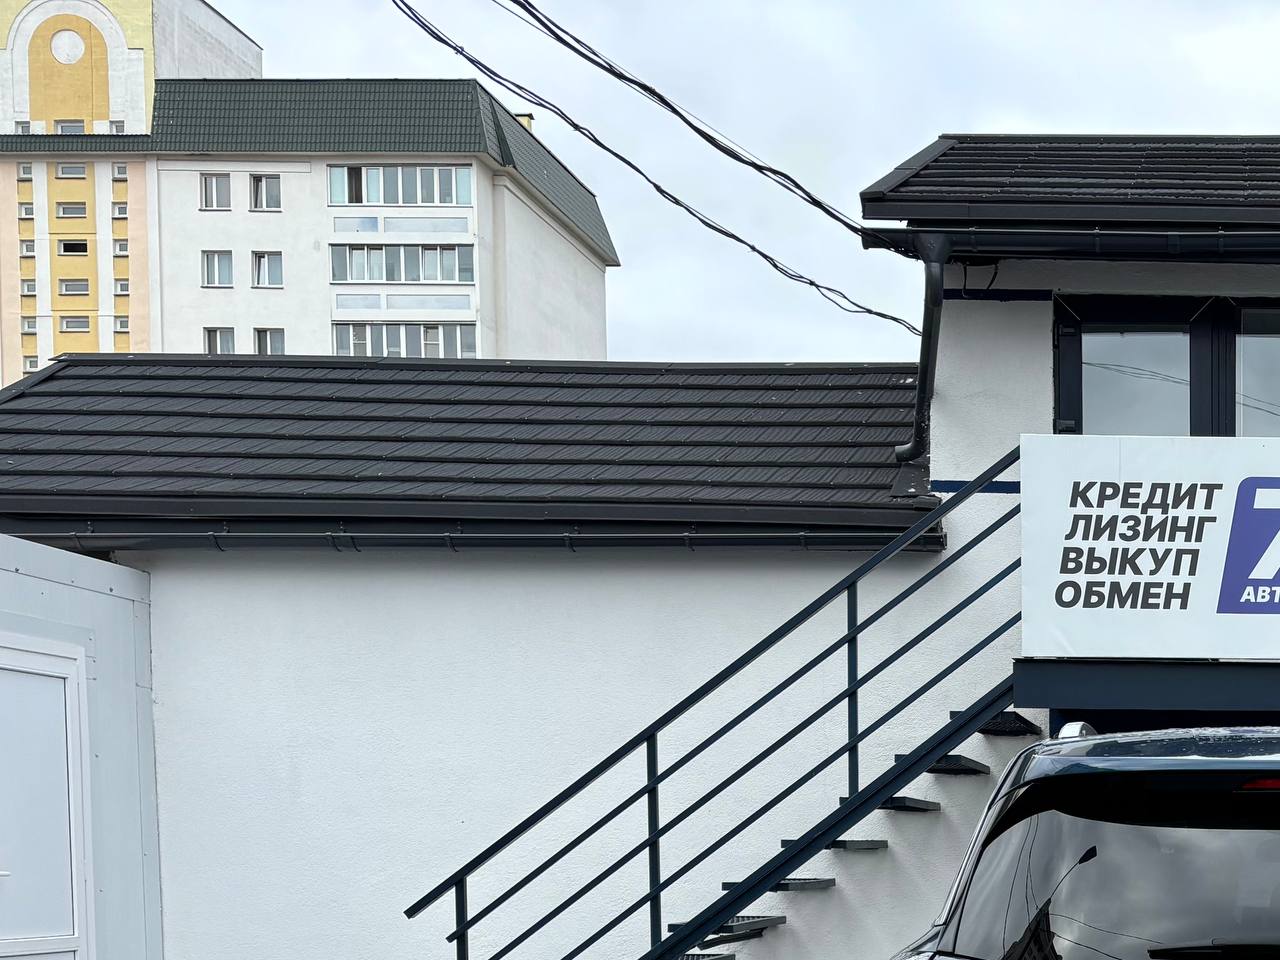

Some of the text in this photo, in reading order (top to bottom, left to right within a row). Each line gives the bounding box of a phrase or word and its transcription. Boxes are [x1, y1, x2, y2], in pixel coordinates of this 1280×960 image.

[1069, 481, 1223, 514] КРЕДИТ
[1064, 514, 1217, 542] ЛИЗИНГ
[1059, 547, 1200, 576] ВЫКУП
[1054, 580, 1192, 610] ОБМЕН
